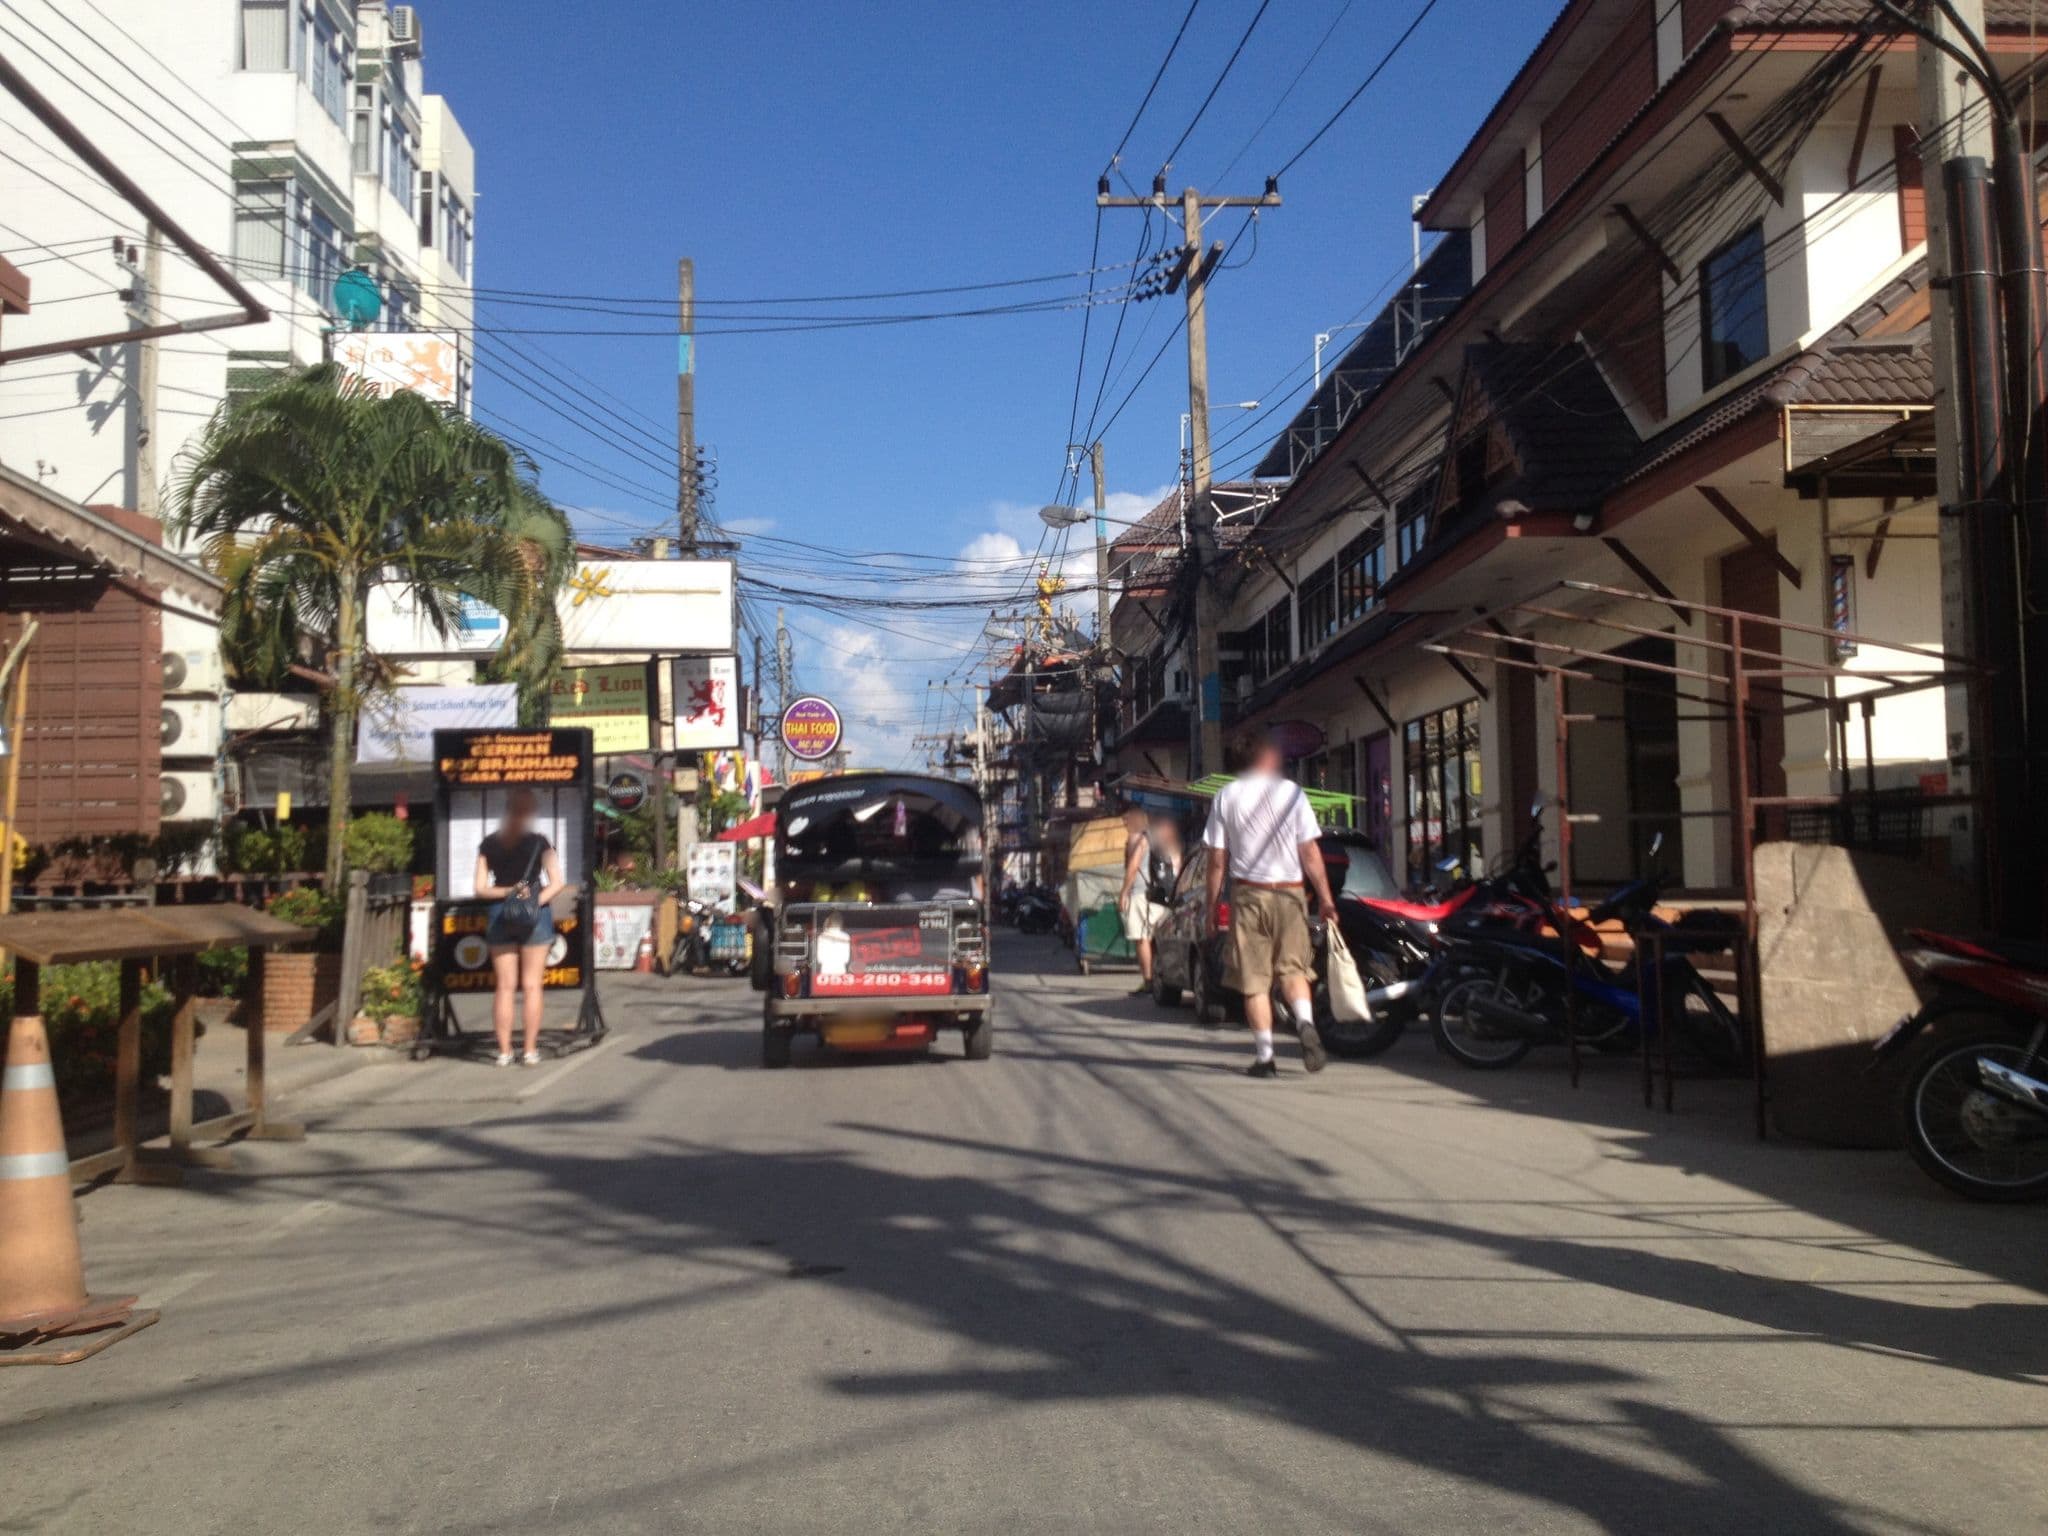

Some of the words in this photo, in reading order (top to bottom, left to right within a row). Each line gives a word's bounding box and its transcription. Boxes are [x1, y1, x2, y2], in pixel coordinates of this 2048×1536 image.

[599, 675, 643, 693] Lion
[785, 722, 808, 735] THAI
[811, 722, 836, 735] FOOD
[470, 742, 550, 757] GERMAN
[816, 973, 946, 987] 053-280-345
